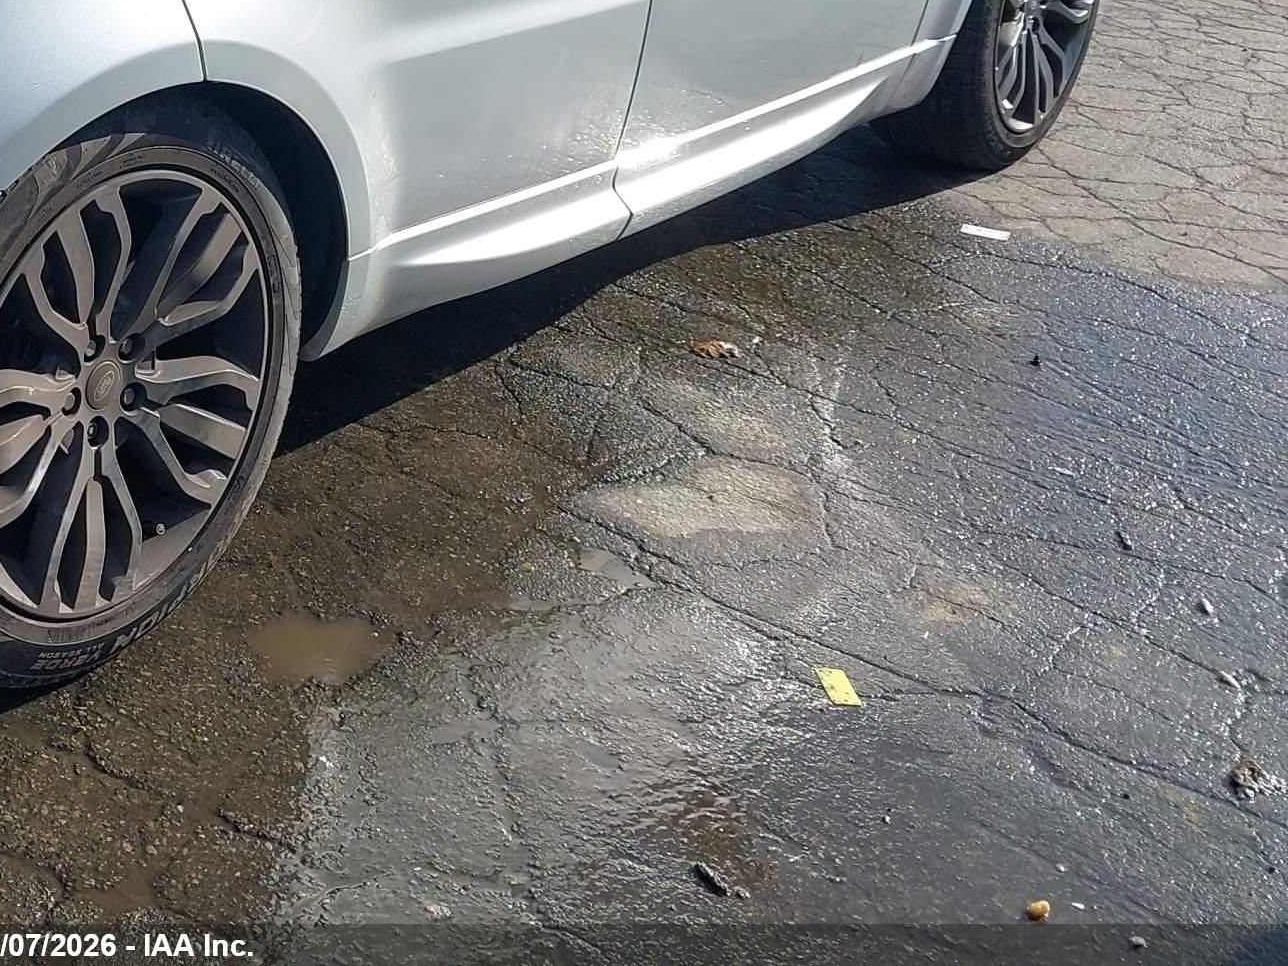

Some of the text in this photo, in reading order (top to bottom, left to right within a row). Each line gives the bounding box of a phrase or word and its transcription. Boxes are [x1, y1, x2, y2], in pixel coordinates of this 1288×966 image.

[30, 649, 103, 670] VERDE
[38, 642, 106, 659] ALL SEASON
